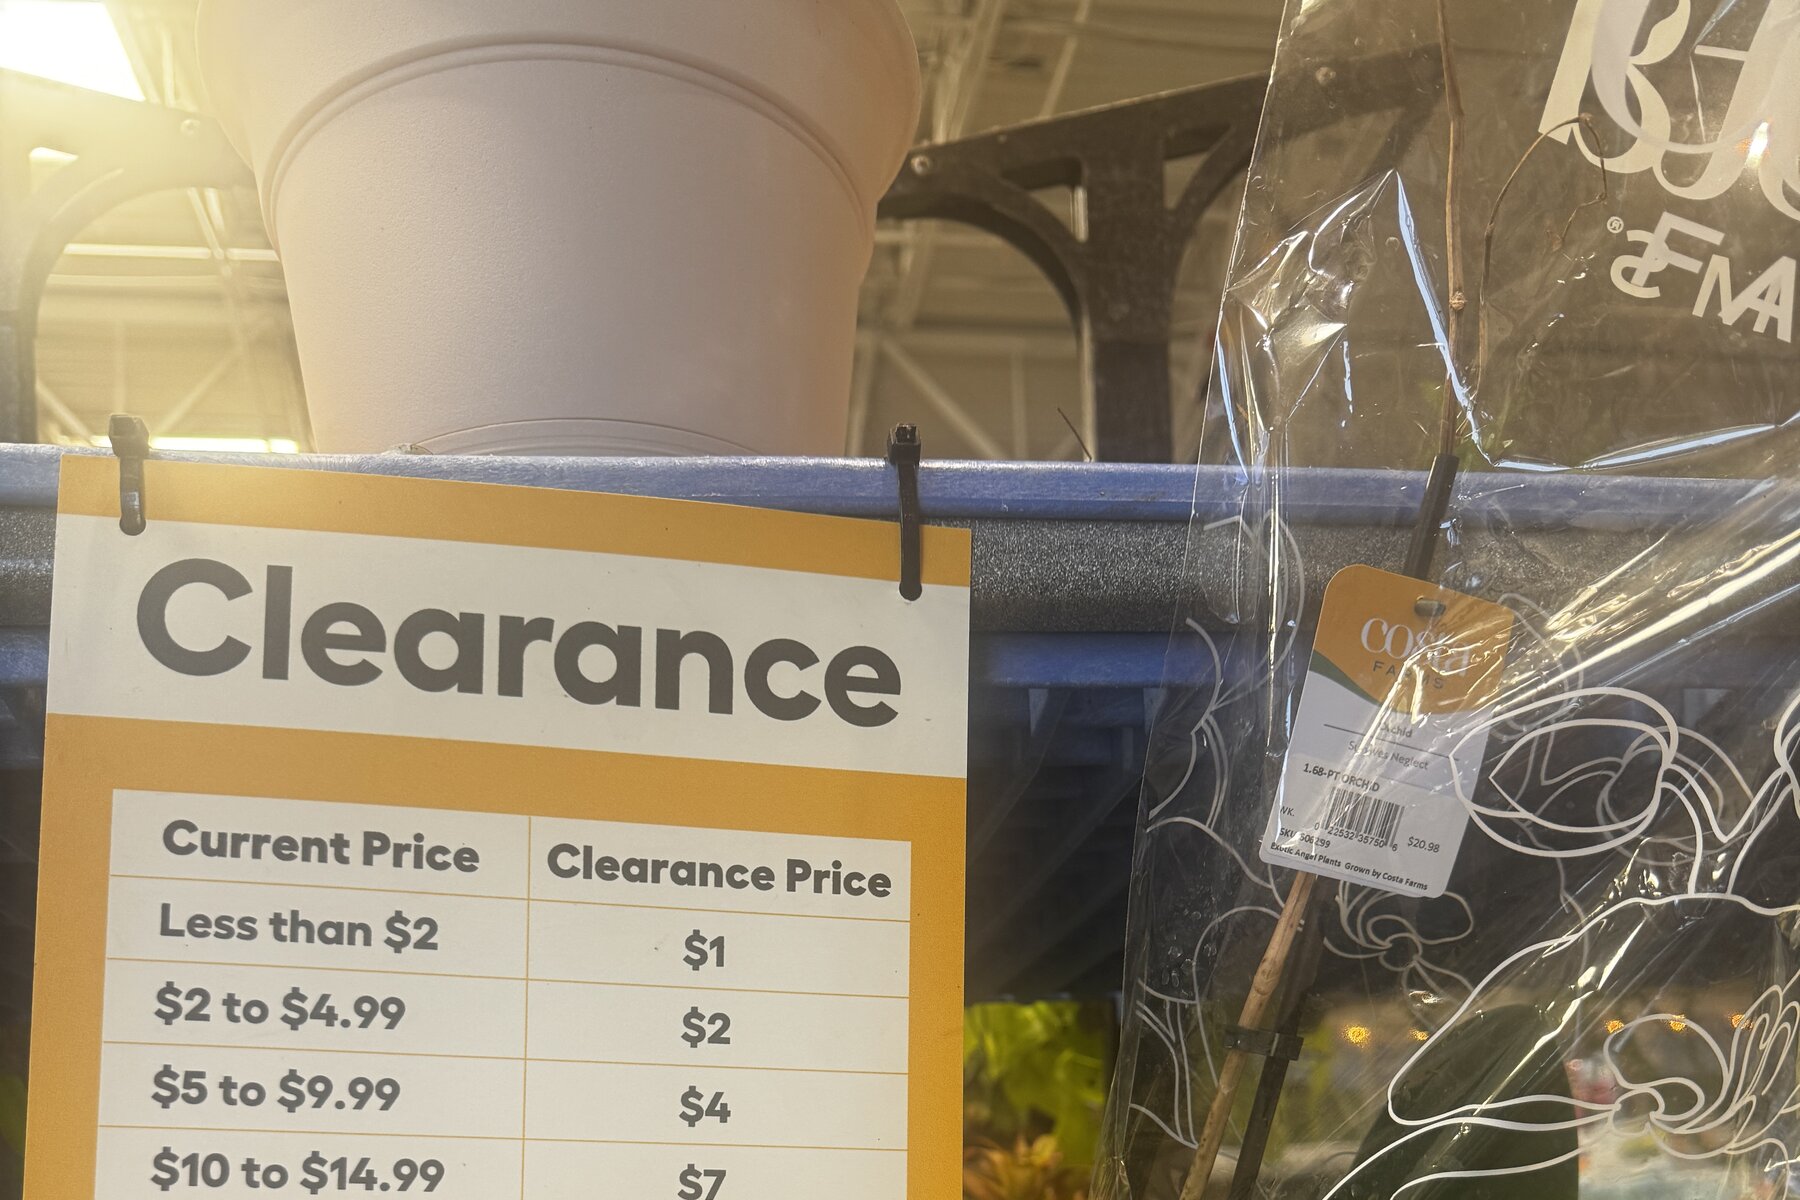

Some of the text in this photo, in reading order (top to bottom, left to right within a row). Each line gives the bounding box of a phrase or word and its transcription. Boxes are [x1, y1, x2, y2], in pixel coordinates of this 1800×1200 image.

[136, 557, 902, 728] Clearance
[1303, 763, 1339, 781] 1.68-PT
[1391, 751, 1429, 771] Neglect
[163, 819, 480, 873] Current Price
[1327, 827, 1355, 841] 22532
[1357, 833, 1385, 848] 35750
[1407, 836, 1440, 853] $20.98
[547, 843, 892, 898] Clearance Price
[1295, 848, 1317, 861] Angel
[1318, 854, 1342, 868] Plants
[1344, 862, 1370, 876] Grown
[1372, 868, 1382, 879] by
[1382, 872, 1404, 885] Costa
[1404, 878, 1428, 891] Farms
[160, 902, 439, 954] Less than $2
[683, 928, 725, 972] $1
[154, 981, 406, 1031] $2 to $4.99
[681, 1006, 731, 1049] $2
[152, 1064, 401, 1113] $5 to $9.99
[679, 1085, 731, 1127] $4
[151, 1146, 445, 1195] $10 to $14.99
